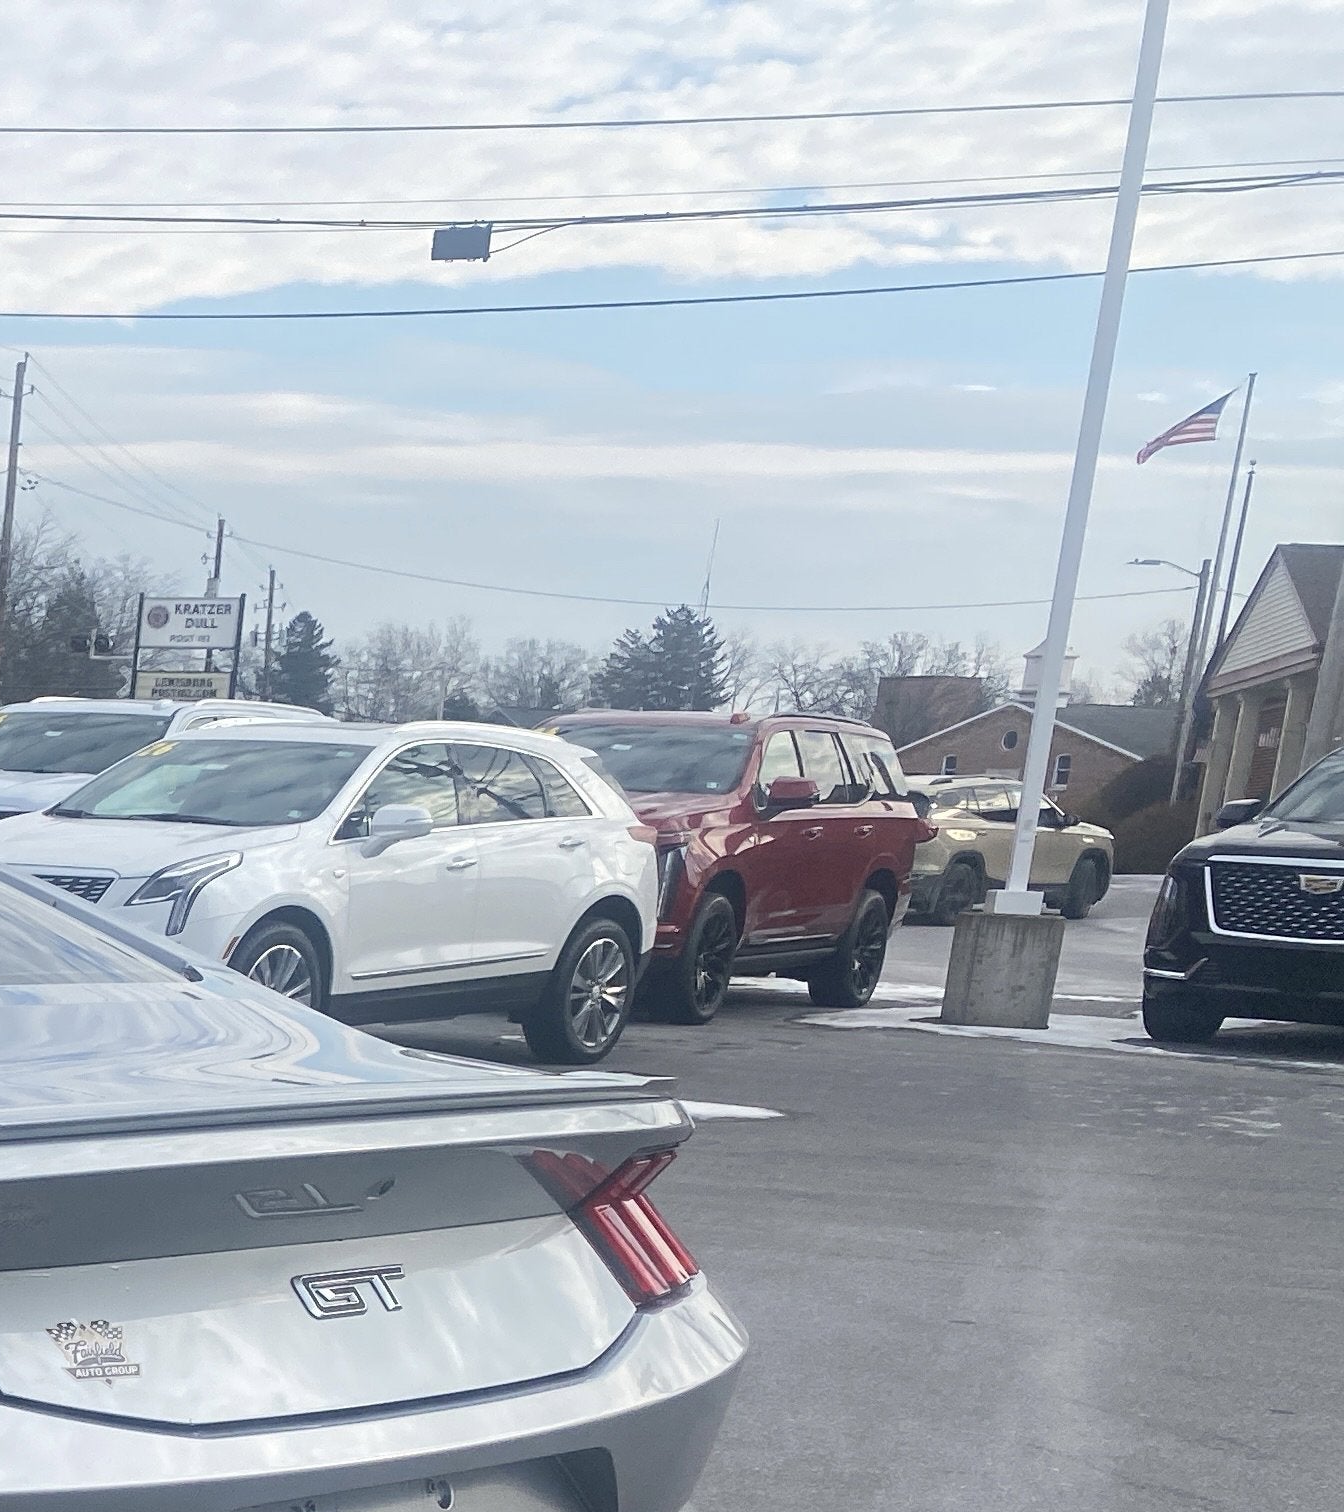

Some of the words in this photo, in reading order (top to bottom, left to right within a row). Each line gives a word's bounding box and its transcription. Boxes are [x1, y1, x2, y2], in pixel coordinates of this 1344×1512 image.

[174, 603, 232, 615] KRATZER
[185, 618, 218, 629] DULL
[291, 1264, 405, 1320] GT
[65, 1340, 123, 1364] Fairfield
[75, 1367, 103, 1378] AUTO
[104, 1365, 139, 1376] GROUP
